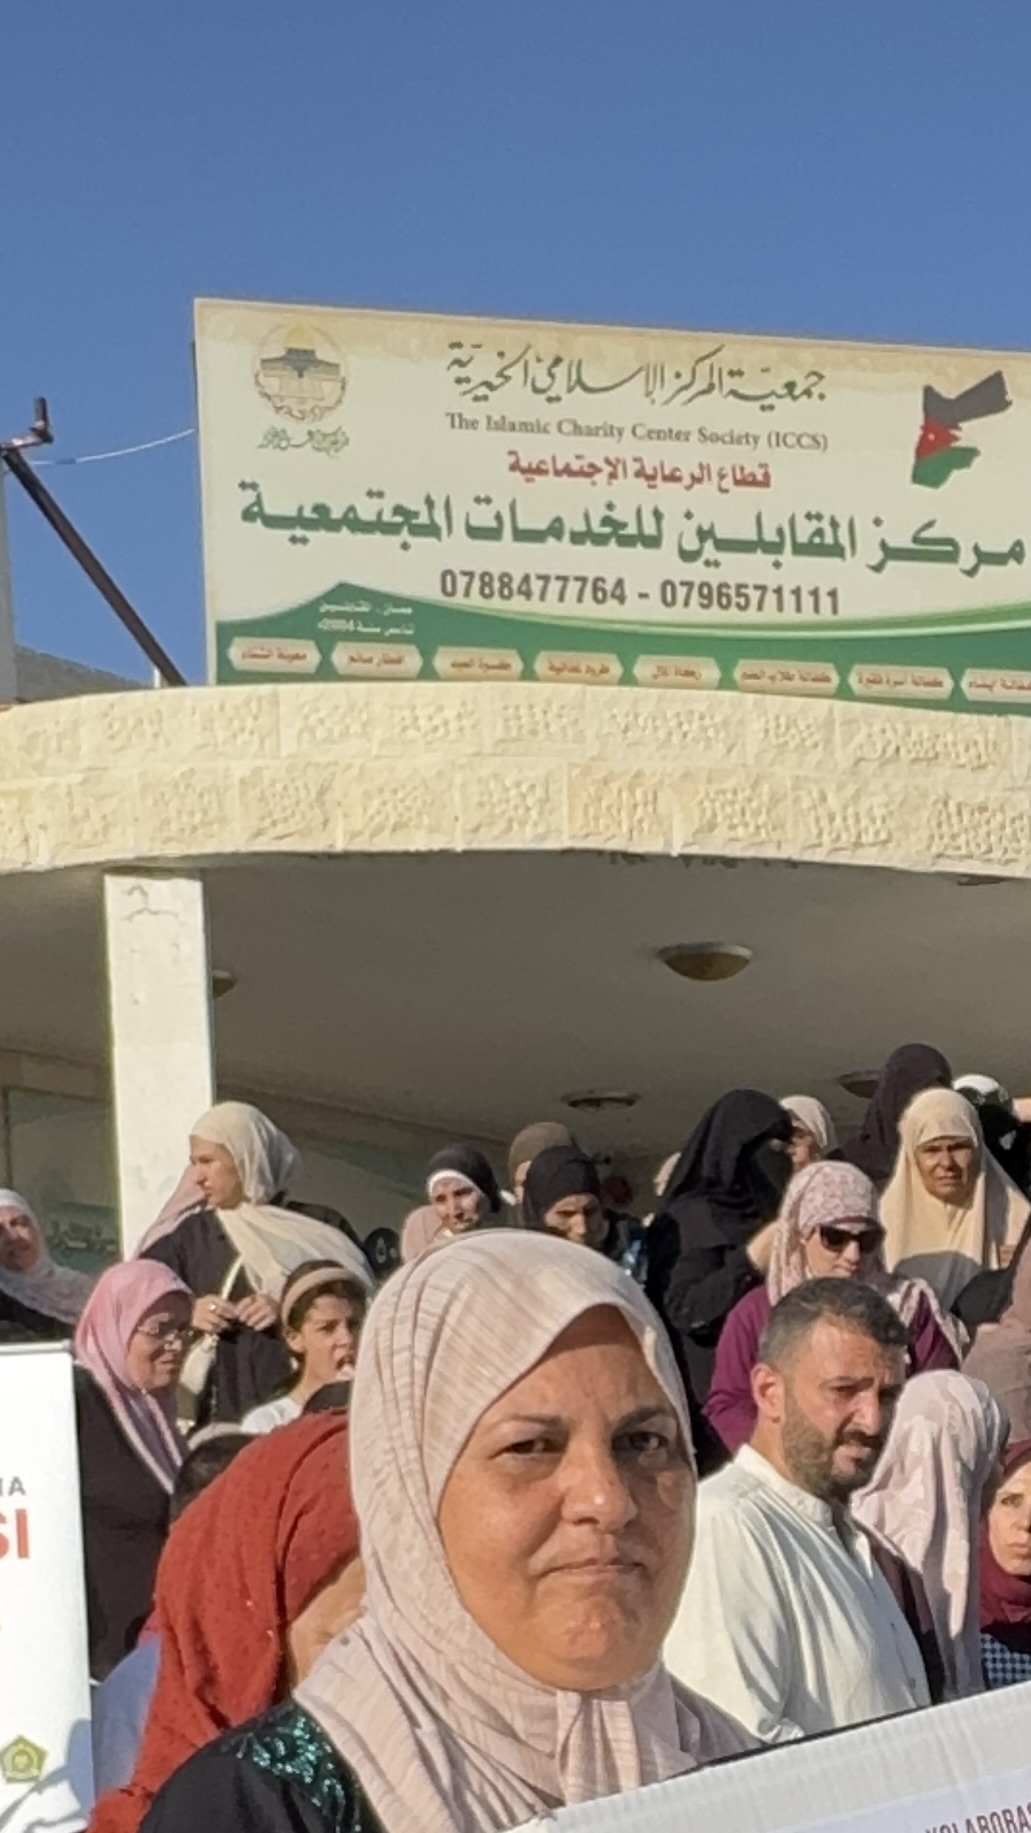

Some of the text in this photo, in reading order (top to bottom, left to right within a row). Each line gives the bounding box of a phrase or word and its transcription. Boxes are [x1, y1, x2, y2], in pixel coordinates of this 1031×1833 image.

[446, 412, 829, 453] The Islamic Charity Center Society (ICCS)
[632, 456, 712, 491] الرعاية
[717, 462, 772, 493] قطاع
[237, 479, 1026, 580] مركز المقابلين للخدمات المجتمعية
[439, 568, 628, 606] 0788477764
[660, 578, 840, 616] 0796571111
